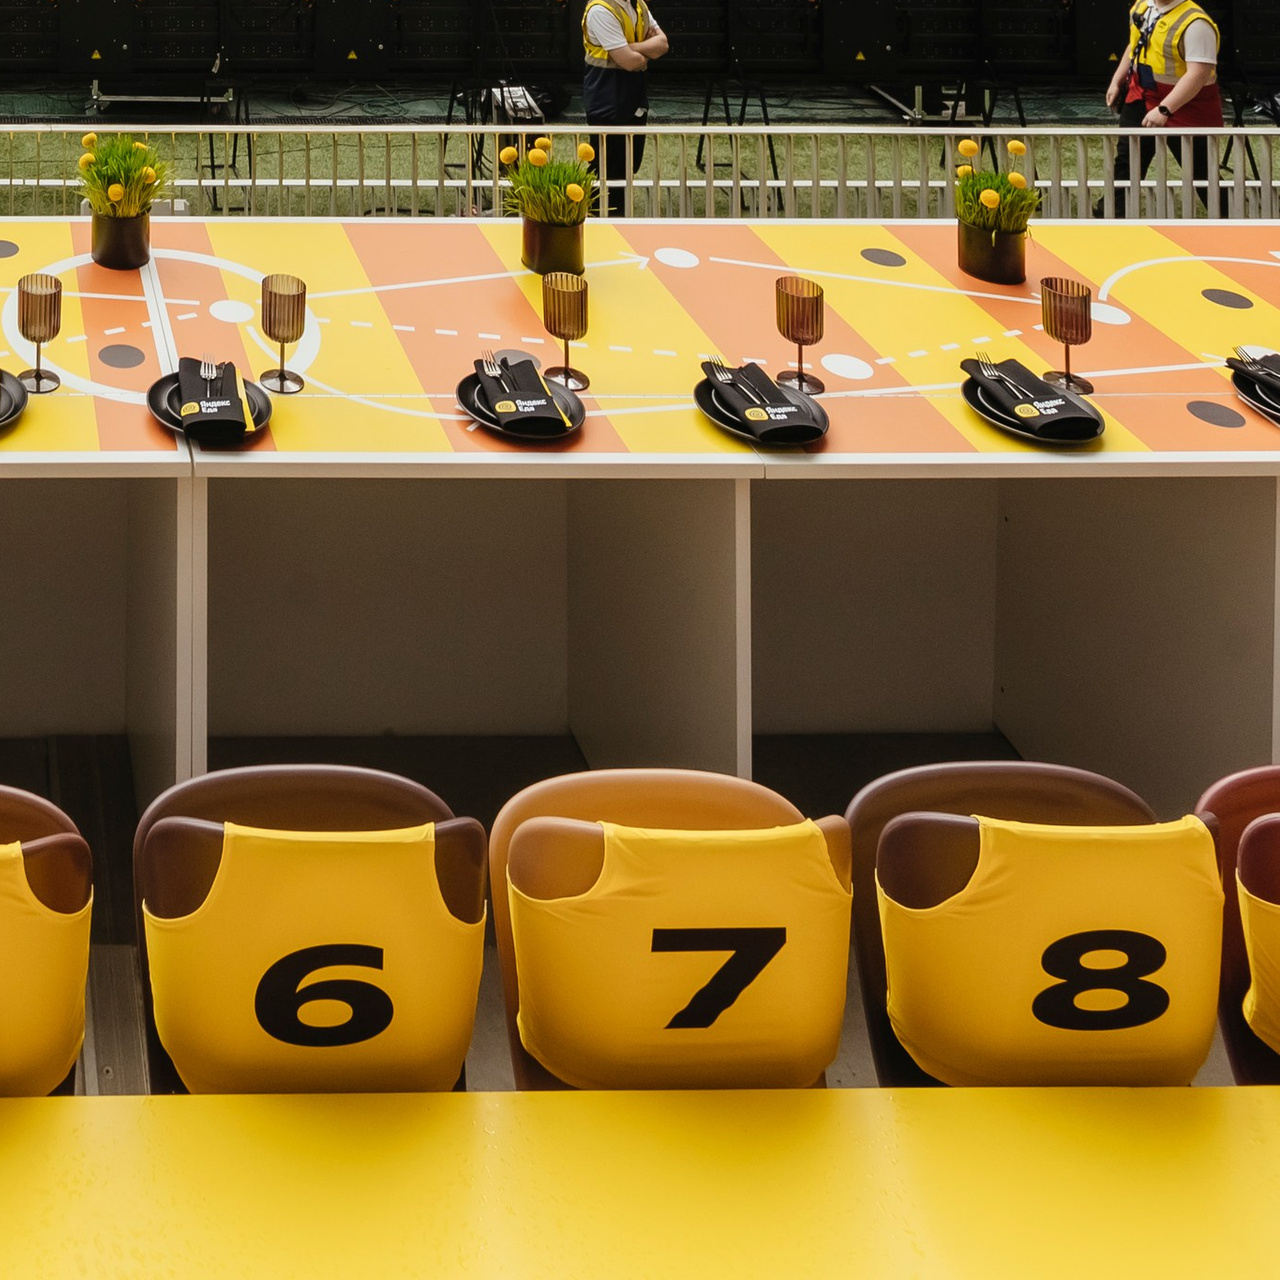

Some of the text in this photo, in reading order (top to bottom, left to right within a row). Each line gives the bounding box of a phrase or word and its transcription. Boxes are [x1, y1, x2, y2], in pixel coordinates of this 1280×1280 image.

[200, 400, 230, 408] Яндекс
[515, 399, 547, 407] Яндекс
[766, 406, 797, 414] Яндекс
[254, 943, 395, 1048] 6
[650, 926, 787, 1030] 7
[1031, 929, 1171, 1032] 8
